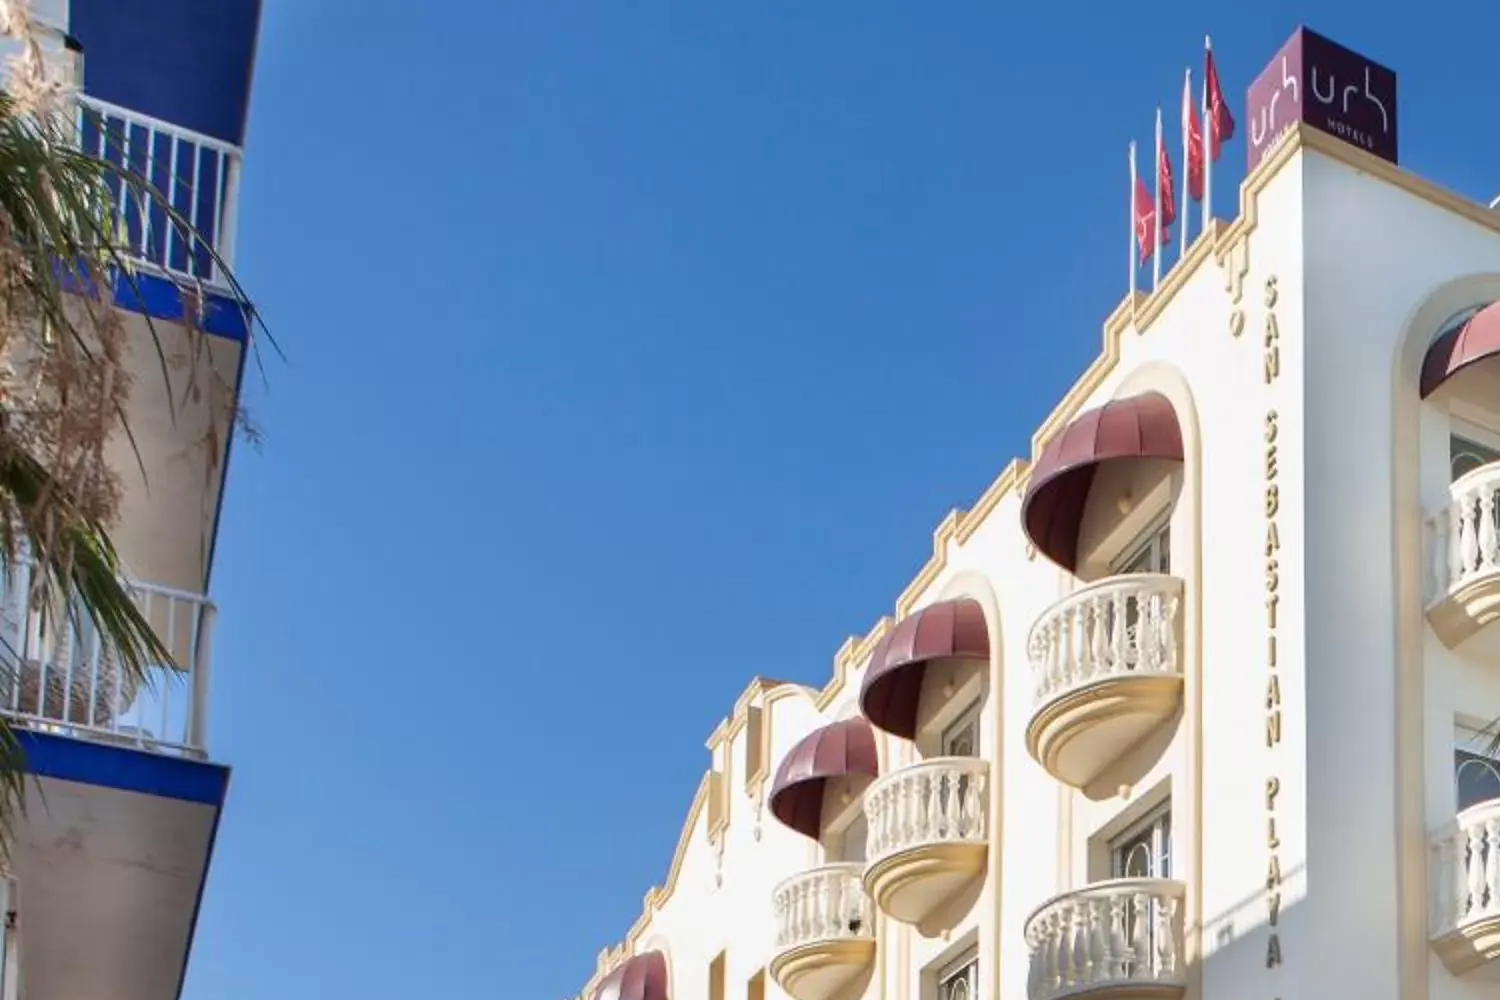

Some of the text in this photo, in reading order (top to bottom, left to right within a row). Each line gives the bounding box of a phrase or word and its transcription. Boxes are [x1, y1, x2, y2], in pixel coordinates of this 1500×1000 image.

[1251, 55, 1298, 146] urh
[1311, 65, 1388, 133] urh
[1263, 275, 1280, 384] SAN
[1264, 410, 1282, 748] SEBASTIAN
[1264, 776, 1283, 969] PLAYA
